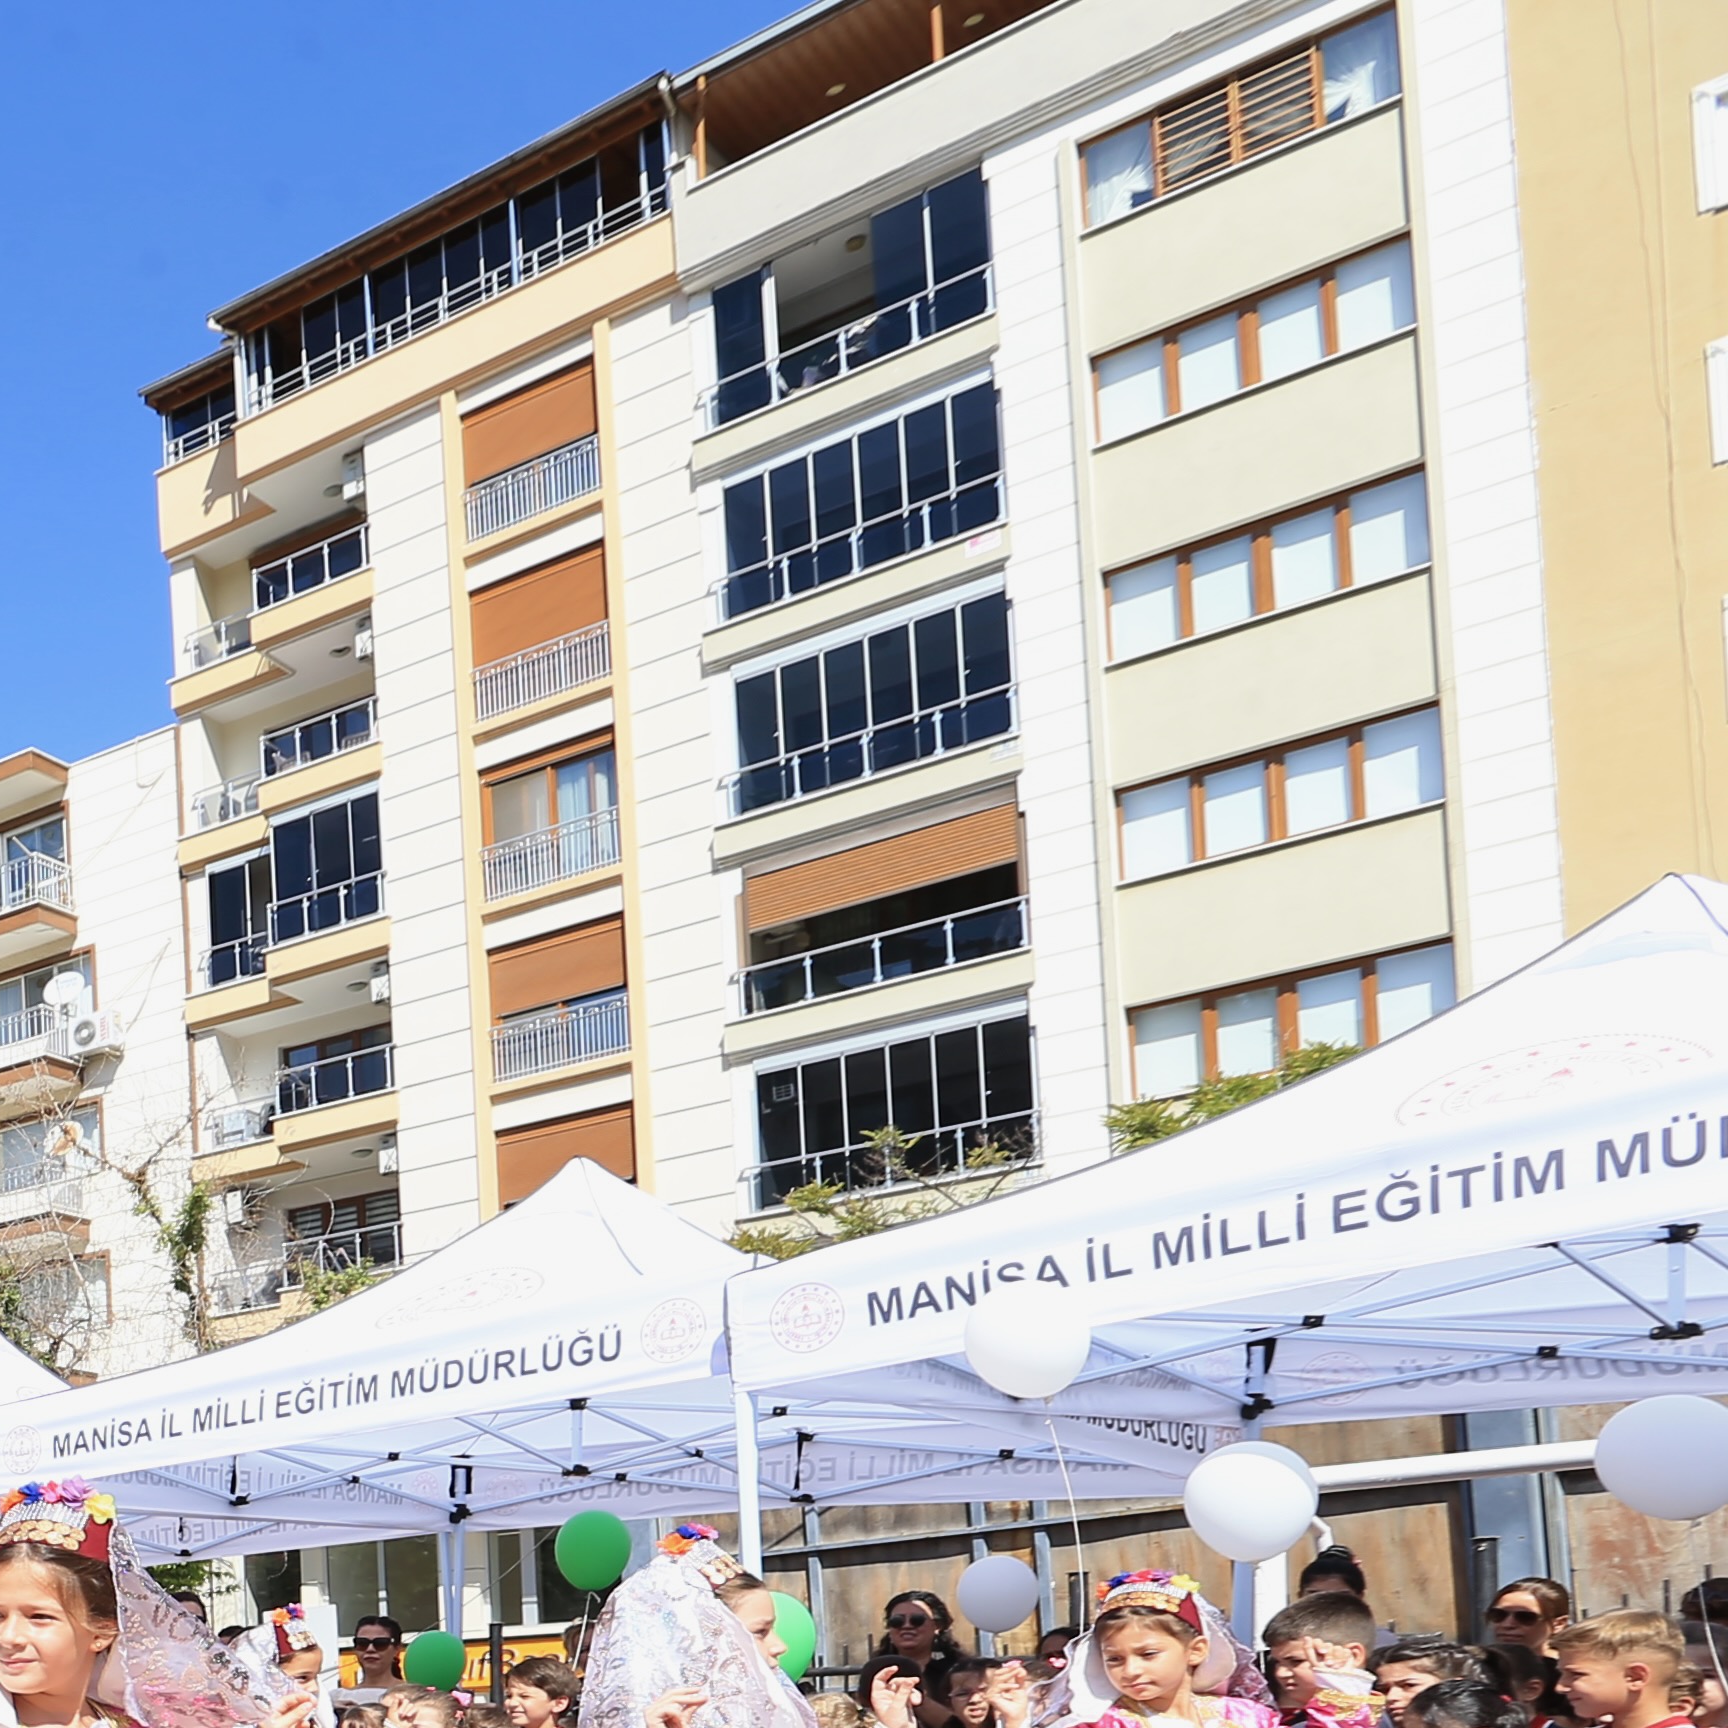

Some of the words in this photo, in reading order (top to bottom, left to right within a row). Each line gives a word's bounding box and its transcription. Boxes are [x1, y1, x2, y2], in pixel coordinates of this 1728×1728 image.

[867, 1256, 1070, 1326] MANİSA
[1085, 1237, 1133, 1283] İL
[1152, 1193, 1306, 1270] MİLLİ
[1332, 1151, 1566, 1234] EĞİTİM
[1595, 1112, 1728, 1183] MÜ
[52, 1417, 152, 1460] MANİSA
[159, 1406, 184, 1440] İL
[192, 1389, 266, 1433] MİLLİ
[275, 1374, 379, 1420] EĞİTİM
[390, 1324, 624, 1400] MÜDÜRLÜĞÜ
